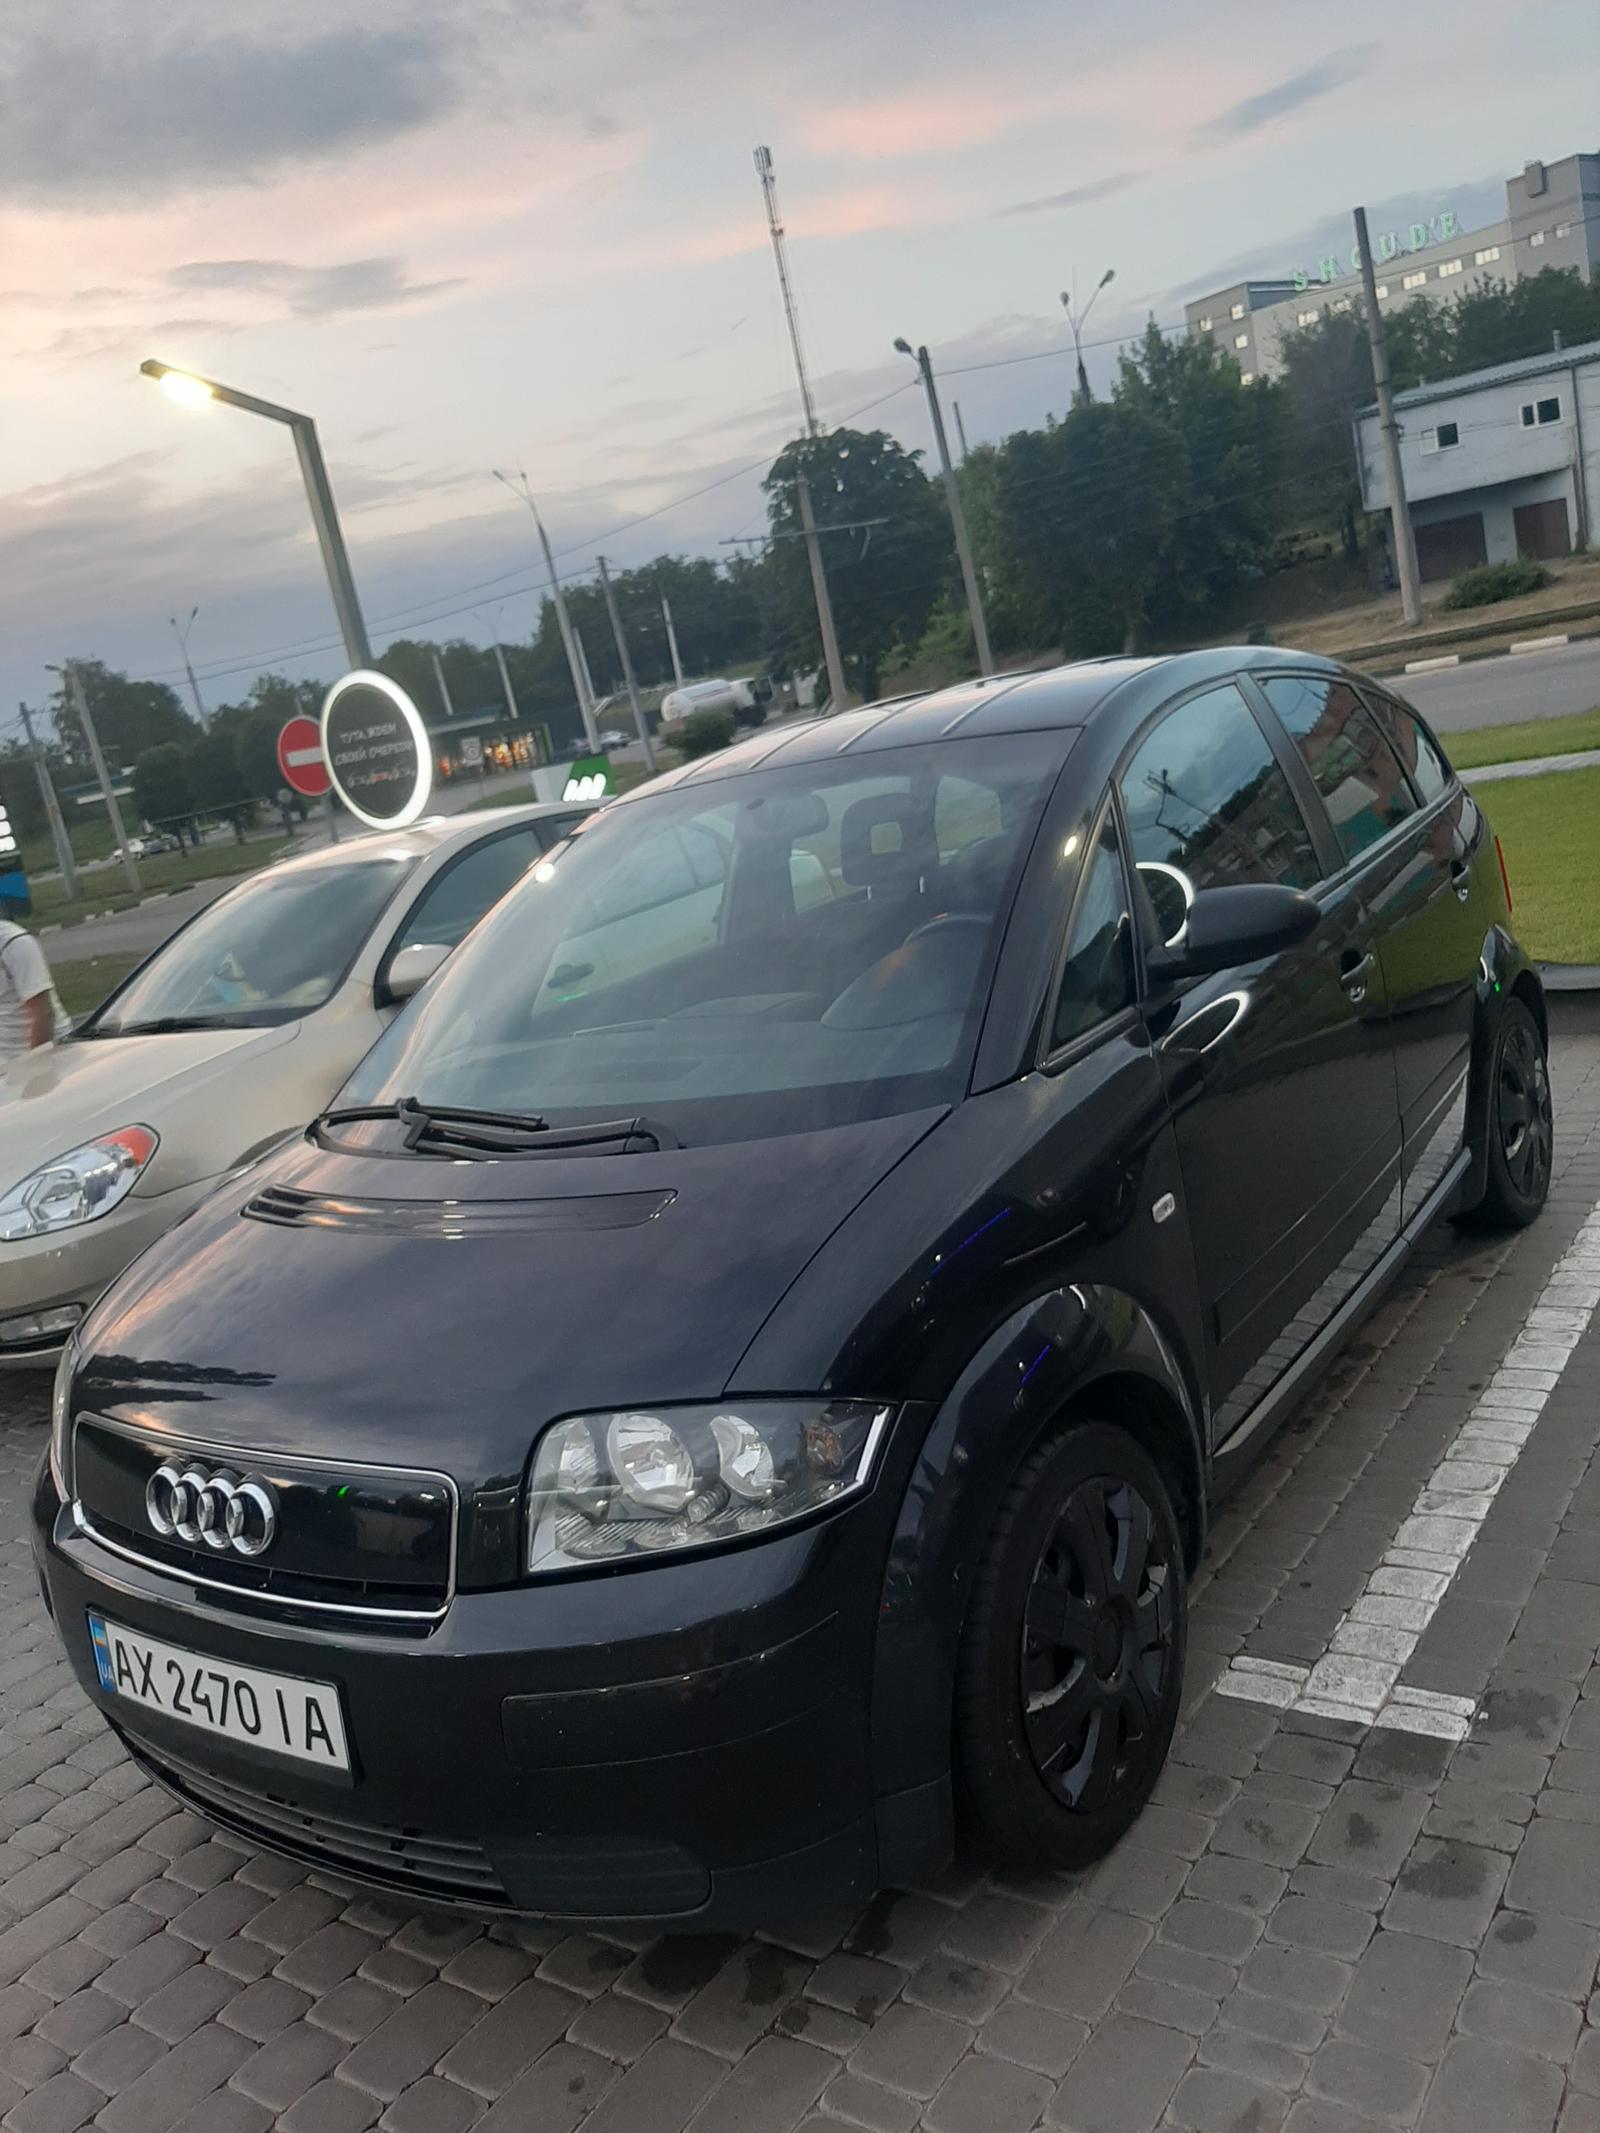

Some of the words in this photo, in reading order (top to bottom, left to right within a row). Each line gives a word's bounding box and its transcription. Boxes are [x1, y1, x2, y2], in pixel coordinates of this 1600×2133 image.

[115, 1639, 162, 1704] AX
[166, 1659, 261, 1736] 2470
[276, 1688, 336, 1757] IA
